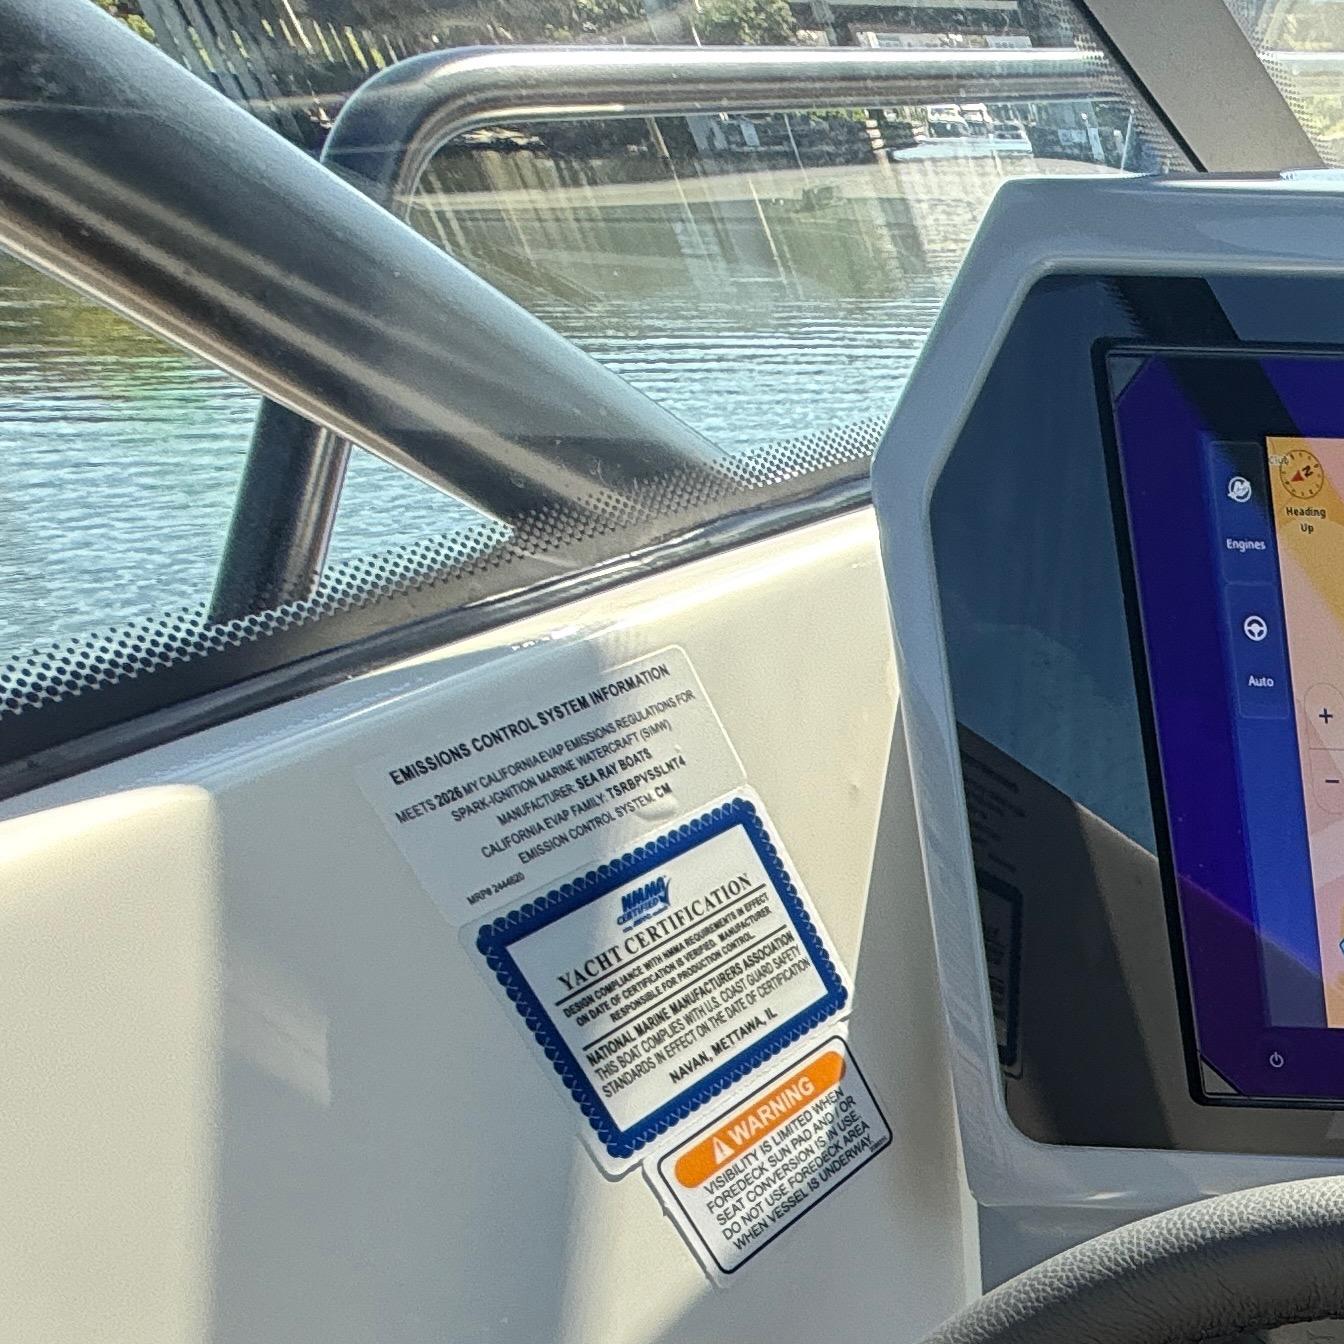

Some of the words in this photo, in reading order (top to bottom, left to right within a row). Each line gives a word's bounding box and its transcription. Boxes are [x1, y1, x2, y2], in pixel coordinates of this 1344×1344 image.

[1226, 538, 1266, 553] Engines
[1286, 507, 1326, 518] Heading
[1300, 523, 1314, 534] Up
[1248, 675, 1274, 688] Auto
[389, 742, 472, 786] EMISSIONS
[470, 715, 539, 753] CONTROL
[536, 694, 590, 726] SYSTEM
[588, 662, 670, 705] INFORMATION
[574, 771, 600, 791] SEA
[597, 762, 619, 780] RAY
[617, 747, 652, 771] BOATS
[480, 820, 545, 858] CALIFORNIA
[543, 808, 571, 829] EVAP
[557, 944, 625, 993] YACHT
[622, 872, 753, 956] CERTIFICATION
[586, 1028, 636, 1067] NATIONAL
[633, 1007, 671, 1037] MARINE
[668, 962, 744, 1015] MANUFACTURERS
[741, 930, 795, 970] ASSOCIATION
[668, 1048, 712, 1084] NAVAN,
[711, 1013, 766, 1056] METTAWA,
[764, 1006, 777, 1021] IL
[703, 1149, 760, 1196] VISIBILITY
[758, 1139, 773, 1155] IS
[771, 1109, 814, 1146] LIMITED
[811, 1086, 845, 1115] WHEN
[727, 1075, 815, 1147] WARNING
[706, 1161, 768, 1213] FOREDECK
[766, 1143, 792, 1168] SUN
[789, 1127, 813, 1150] PAD
[811, 1111, 835, 1134] AND
[838, 1095, 856, 1114] OR
[715, 1197, 746, 1226] SEAT
[744, 1143, 815, 1203] CONVERSION
[813, 1135, 826, 1150] IS
[825, 1126, 838, 1141] IN
[721, 1219, 742, 1240] DO
[740, 1200, 766, 1226] NOT
[763, 1183, 788, 1207] USE
[787, 1140, 843, 1189] FOREDECK
[840, 1119, 870, 1146] AREA
[732, 1217, 769, 1251] WHEN
[766, 1187, 808, 1224] VESSEL
[807, 1177, 820, 1192] IS
